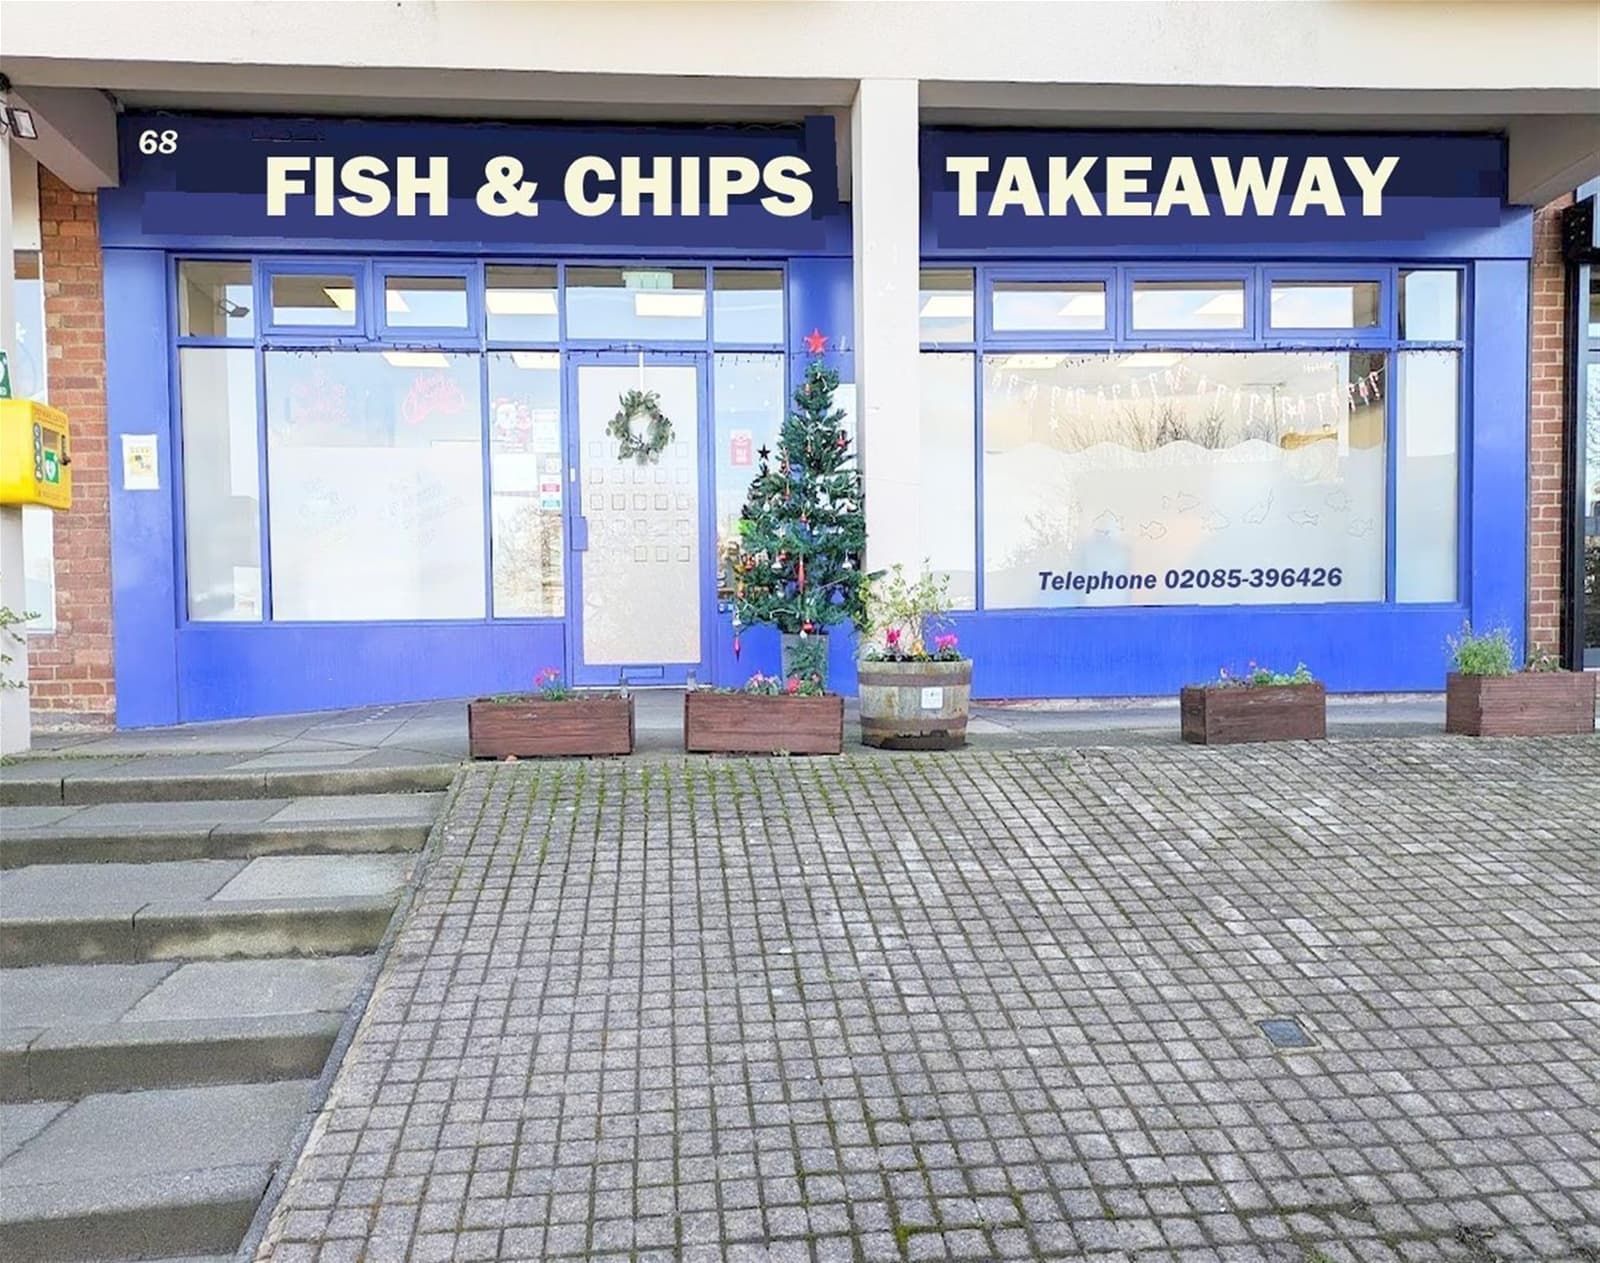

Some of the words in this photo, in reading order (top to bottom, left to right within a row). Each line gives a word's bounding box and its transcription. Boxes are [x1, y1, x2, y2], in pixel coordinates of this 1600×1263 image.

[138, 129, 179, 155] 68
[266, 155, 449, 217] FISH
[475, 155, 539, 217] &
[563, 155, 813, 217] CHIPS
[945, 156, 1400, 217] TAKEAWAY
[1038, 570, 1157, 595] Telephone
[1164, 567, 1343, 589] 02085-396426
